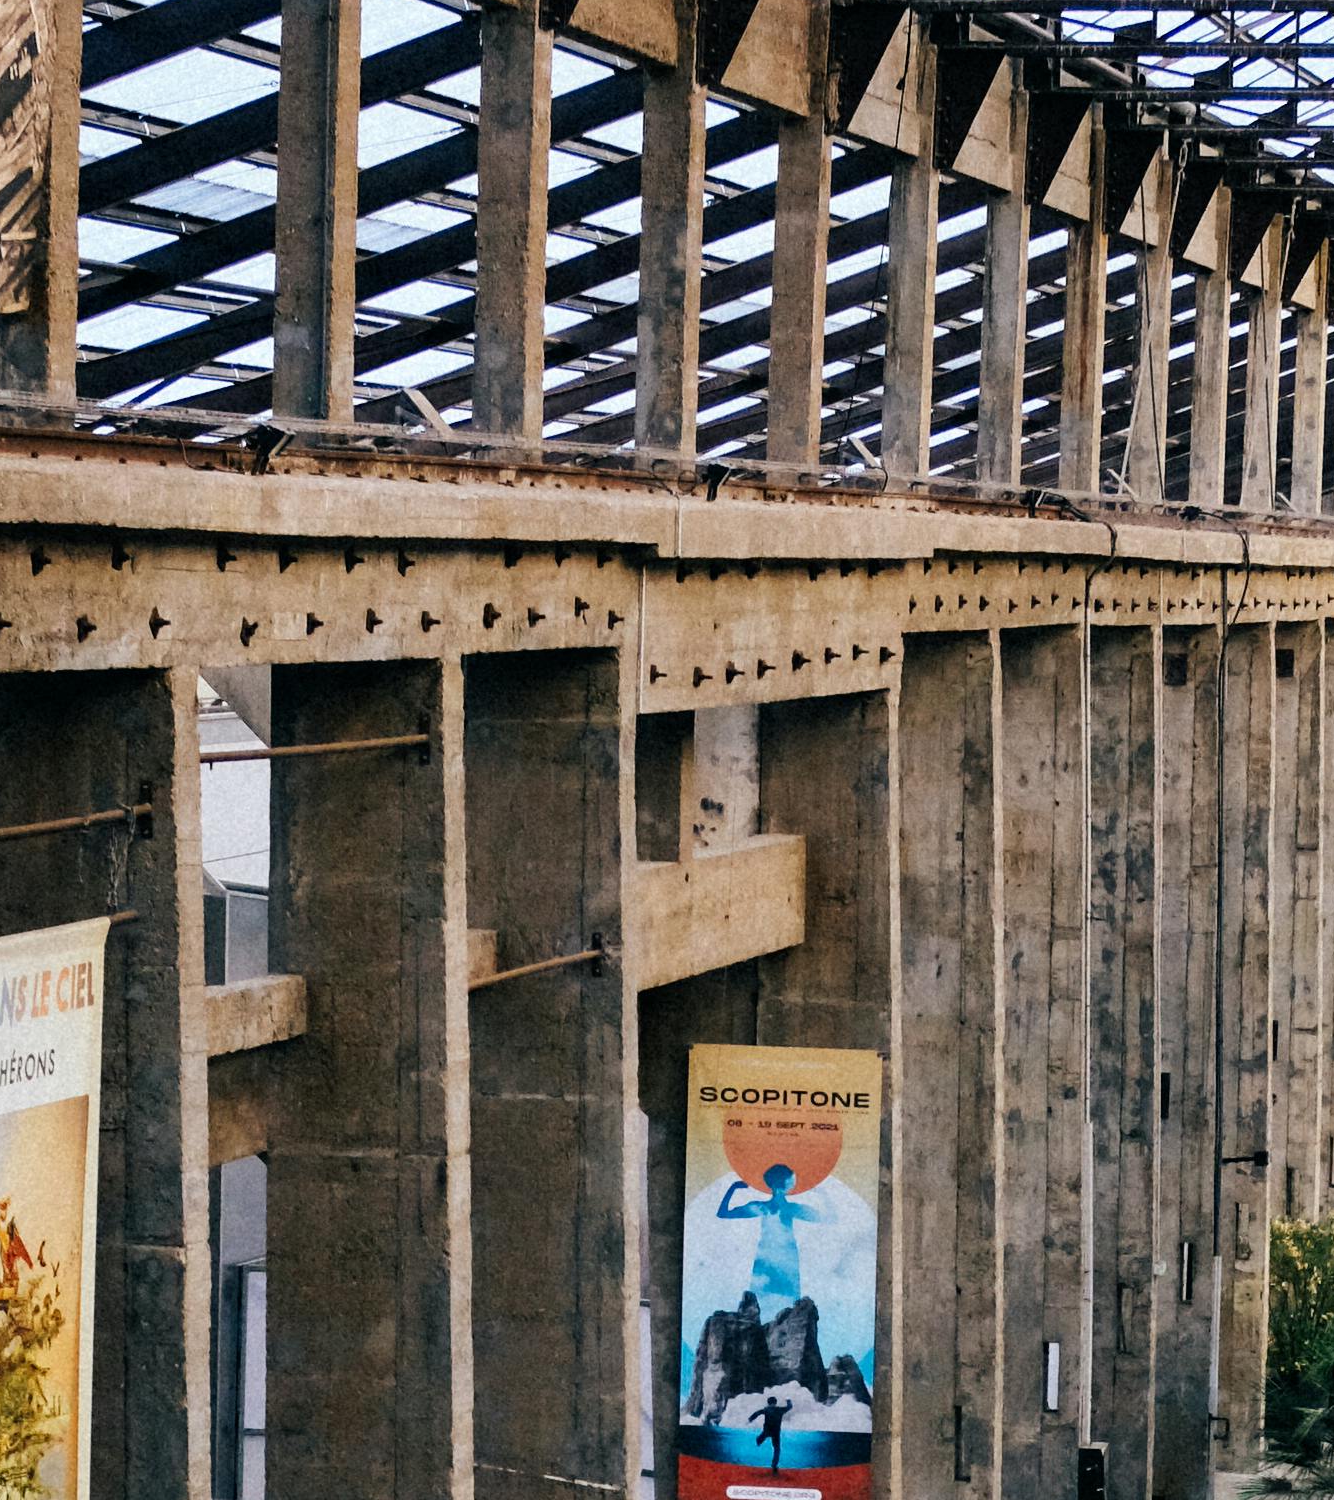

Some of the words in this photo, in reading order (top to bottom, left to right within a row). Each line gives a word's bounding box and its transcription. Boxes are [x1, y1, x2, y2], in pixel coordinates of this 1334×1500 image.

[30, 970, 52, 1019] LE
[56, 960, 95, 1013] CIEL
[699, 1086, 870, 1109] SCOPITONE
[776, 1121, 806, 1130] SEPT
